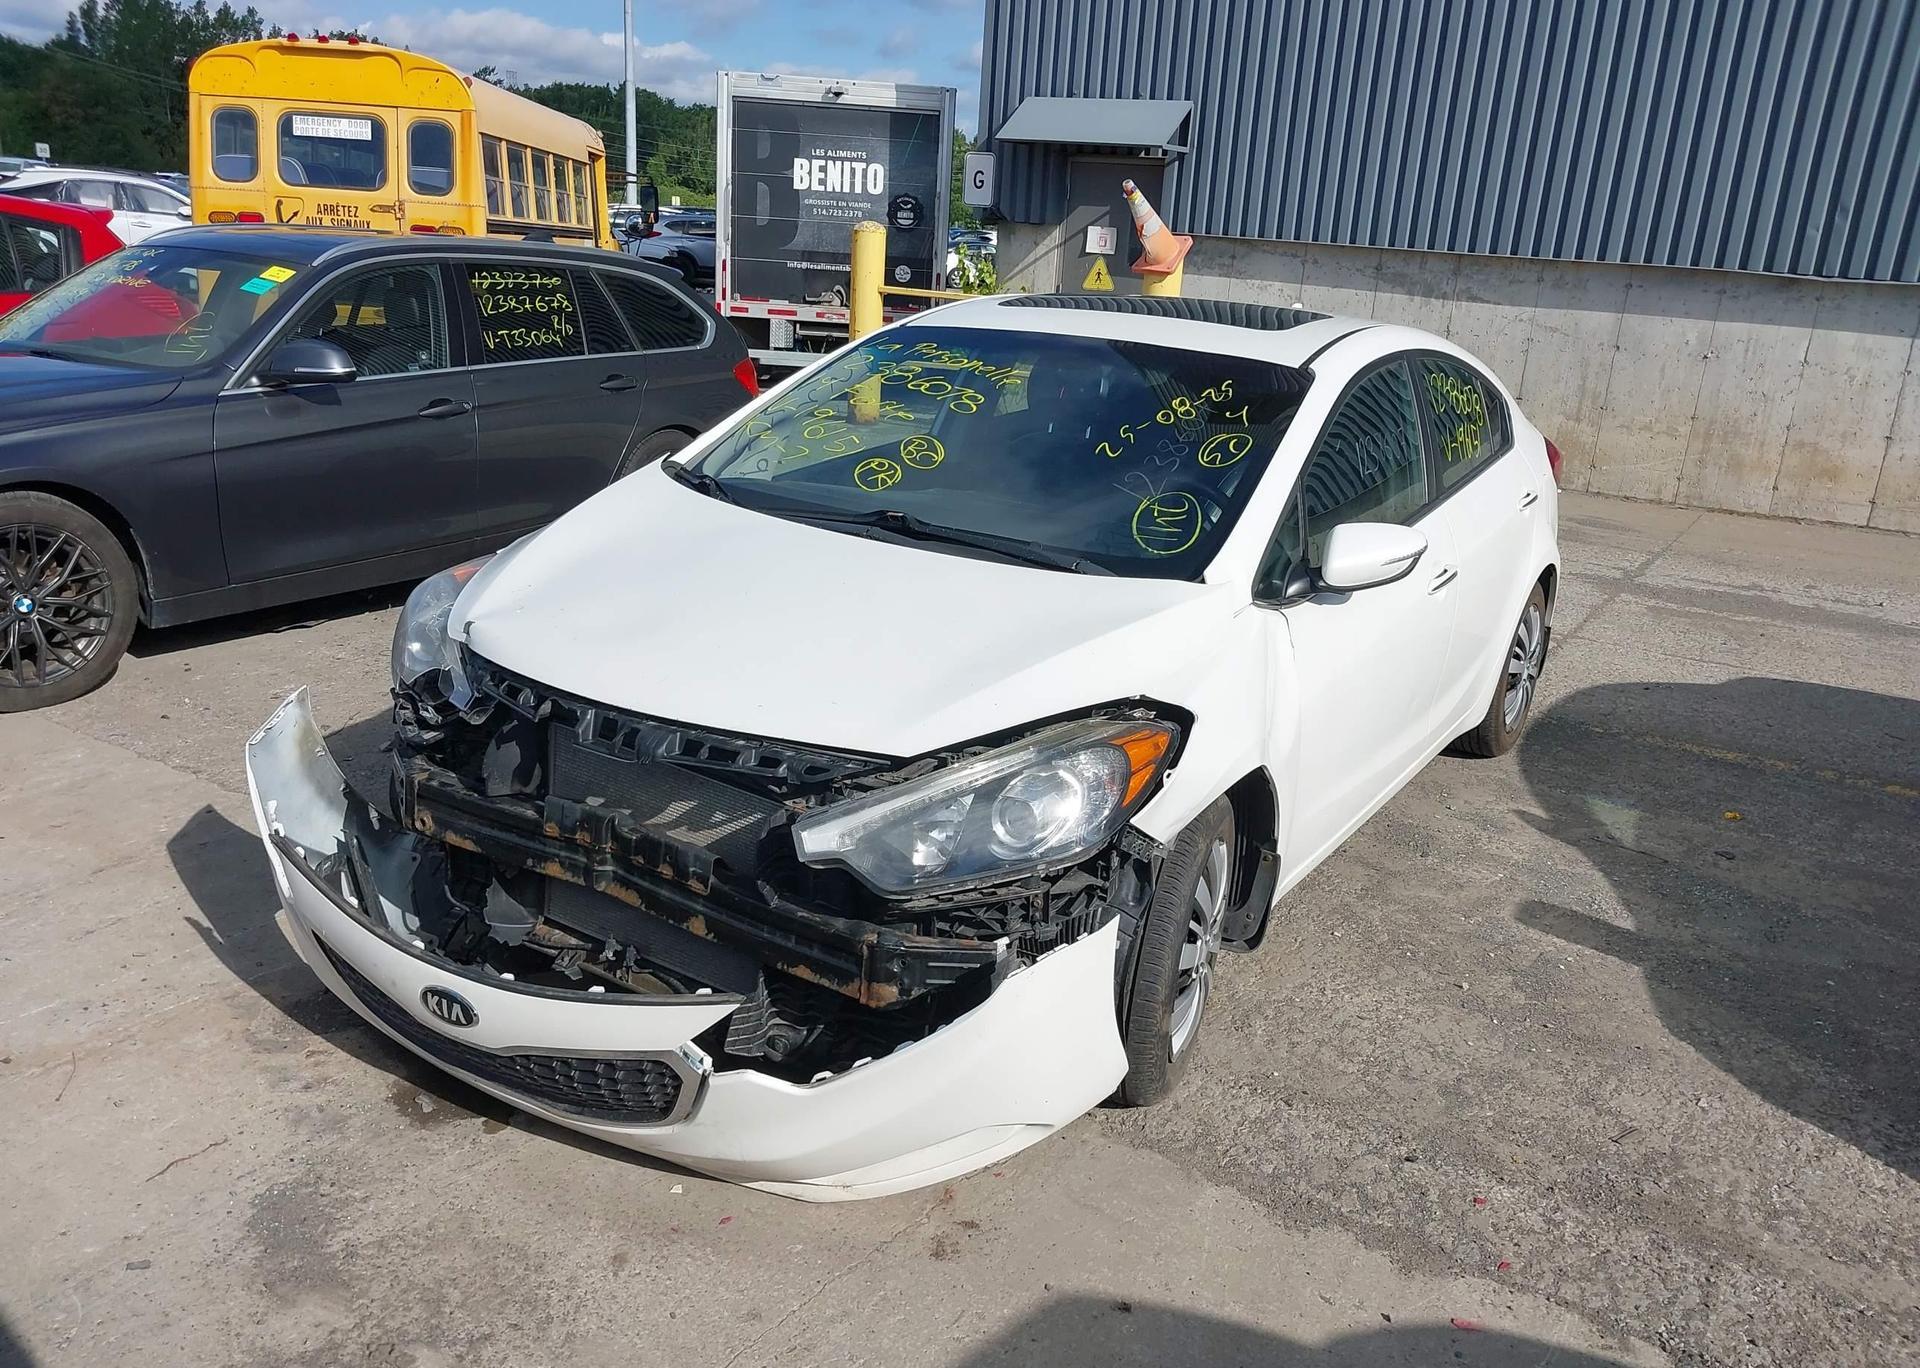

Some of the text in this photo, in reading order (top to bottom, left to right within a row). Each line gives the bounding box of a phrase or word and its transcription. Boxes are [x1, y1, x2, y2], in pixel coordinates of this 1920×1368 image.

[294, 117, 369, 129] EMERGENCY DOOR
[294, 126, 370, 139] PORTE DE SECOURS
[811, 148, 867, 160] LES ALIMENTS
[793, 157, 885, 195] BENITO
[973, 170, 985, 190] G
[316, 201, 360, 218] ARRÊTEZ
[804, 198, 838, 207] GROSSISTE
[848, 201, 872, 209] VIANDE
[305, 216, 371, 229] AUX SIGNAUX
[786, 260, 852, 272] info@lesalimentsb
[477, 293, 573, 317] 12387678
[426, 991, 469, 1025] KIA
